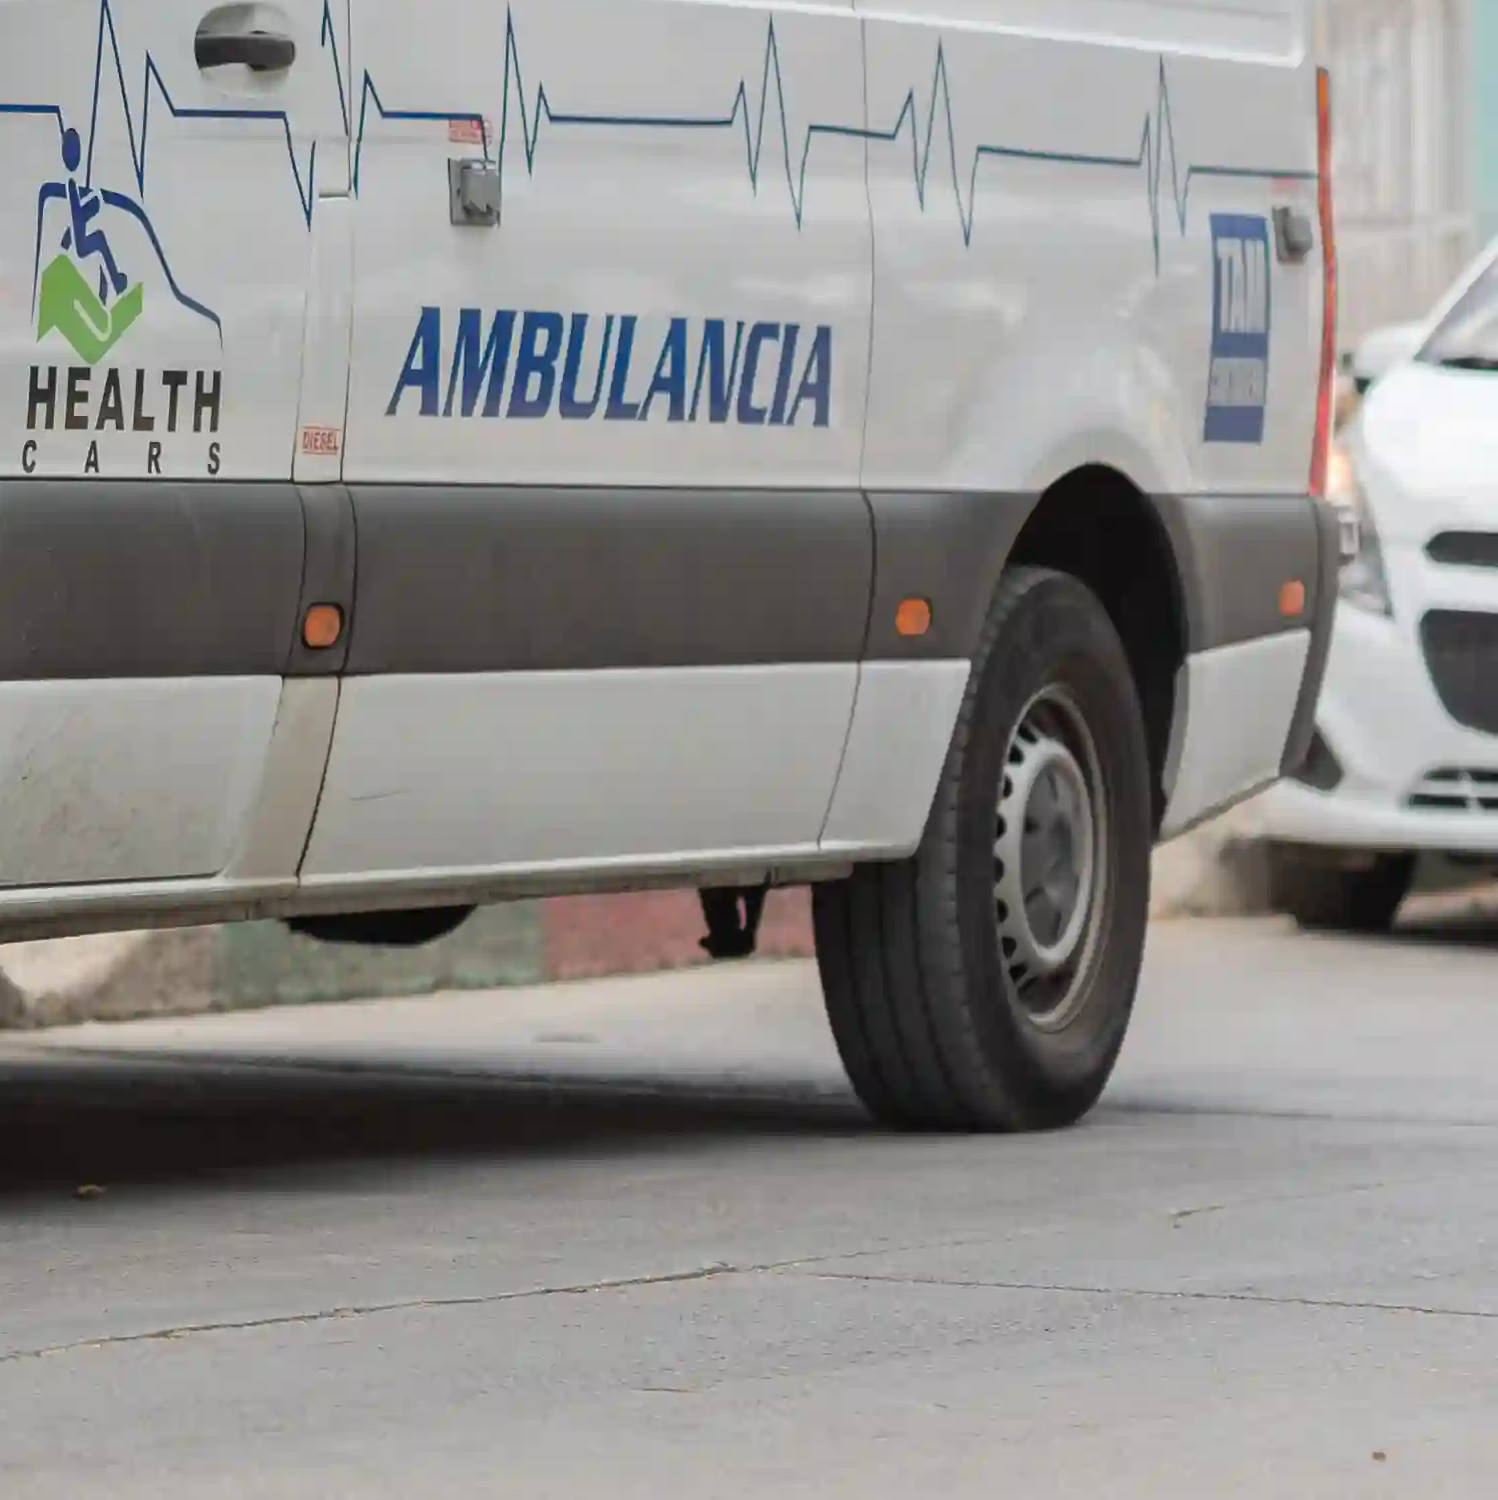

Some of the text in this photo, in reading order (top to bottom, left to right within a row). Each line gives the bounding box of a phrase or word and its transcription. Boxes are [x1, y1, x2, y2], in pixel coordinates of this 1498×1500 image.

[27, 366, 221, 432] HEALTH
[384, 306, 832, 428] AMBULANCIA
[22, 439, 220, 474] CARS
